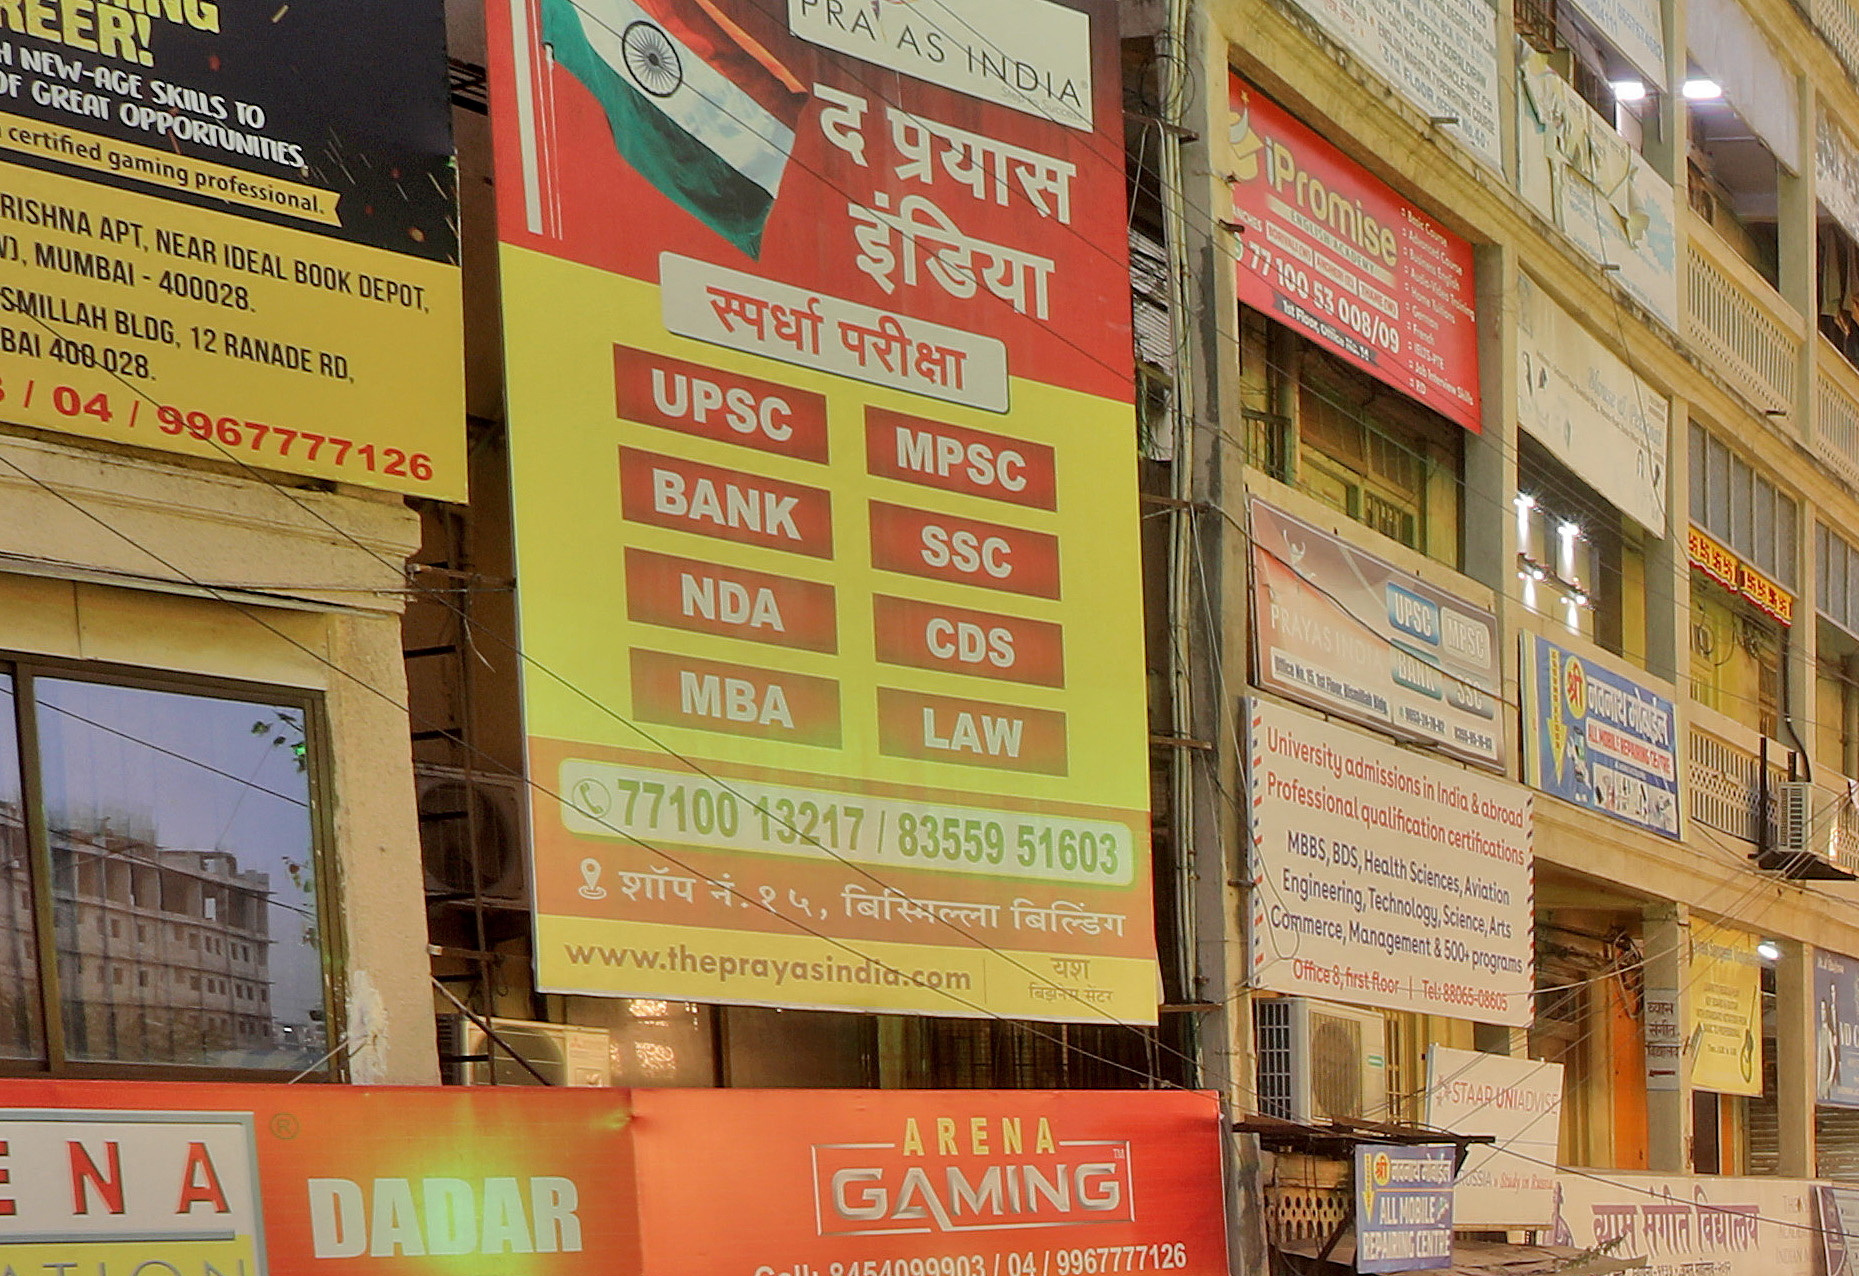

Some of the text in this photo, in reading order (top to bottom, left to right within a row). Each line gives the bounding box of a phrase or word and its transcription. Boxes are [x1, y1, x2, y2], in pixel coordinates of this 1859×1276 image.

[19, 46, 143, 100] NEW-AGE
[150, 80, 228, 120] SKILLS
[235, 100, 266, 130] TO
[31, 79, 111, 121] GREAT
[966, 46, 1082, 108] INDIA
[9, 125, 326, 215] certified gaming professional.
[812, 82, 1076, 224] द प्रयास
[1265, 136, 1398, 267] iPromise
[0, 193, 430, 314] RISHNA APT, NEAR IDEAL BOOK DEPOT,
[35, 242, 256, 313] MUMBAI 400028.
[848, 190, 1055, 321] इंडिया
[1249, 241, 1399, 354] 77 100 53 008/09
[50, 338, 96, 369] 400
[103, 348, 157, 381] 028.
[115, 310, 181, 349] BLDG,
[191, 326, 217, 354] 12
[224, 333, 311, 374] RANADE
[320, 353, 354, 382] RD,
[707, 284, 967, 391] स्पर्धा परीक्षा
[53, 386, 433, 482] 04 9967777126
[651, 368, 793, 441] UPSC
[895, 426, 1027, 491] MPSC
[652, 468, 803, 539] BANK
[921, 525, 1012, 579] SSC
[680, 573, 786, 633] NDA
[1270, 603, 1333, 655] PRAYAS
[1394, 592, 1485, 660] UPSC MPSC
[926, 618, 1015, 668] CDS
[680, 671, 794, 728] MBA
[922, 707, 1023, 758] LAW
[1267, 726, 1523, 829] University admissions in India & abroad
[616, 778, 1118, 876] 77100 13217 83559 51603
[1267, 771, 1524, 866] Professional qualification certifications
[619, 864, 696, 904] शॉप
[841, 884, 1000, 931] बिस्मिल्ला
[1011, 900, 1126, 939] बिल्डिंग
[1283, 867, 1511, 938] Engineering, Technology, Science, Arts
[1287, 830, 1510, 905] MBBS, BDS, Health Sciences, Aviation
[563, 941, 971, 993] www.theprayasindia.com
[1049, 956, 1092, 982] यश
[1270, 905, 1523, 975] Commerce, Management & 500+ programs
[1293, 958, 1331, 984] Office
[1332, 965, 1344, 990] 8,
[1345, 967, 1369, 990] first
[1370, 971, 1400, 994] floor
[1422, 979, 1441, 1000] Tel:
[1452, 1082, 1559, 1115] STAAR UNIADVISE
[902, 1116, 1056, 1156] ARENA
[308, 1176, 582, 1259] DADAR
[830, 1161, 1121, 1229] GAMING
[1380, 1197, 1435, 1225] ALL MOBILE
[1640, 1184, 1692, 1257] संगीत
[1693, 1184, 1760, 1252] विद्यालय
[1056, 1241, 1188, 1276] 9967777126
[1363, 1229, 1451, 1260] REPAIRING CENTRE
